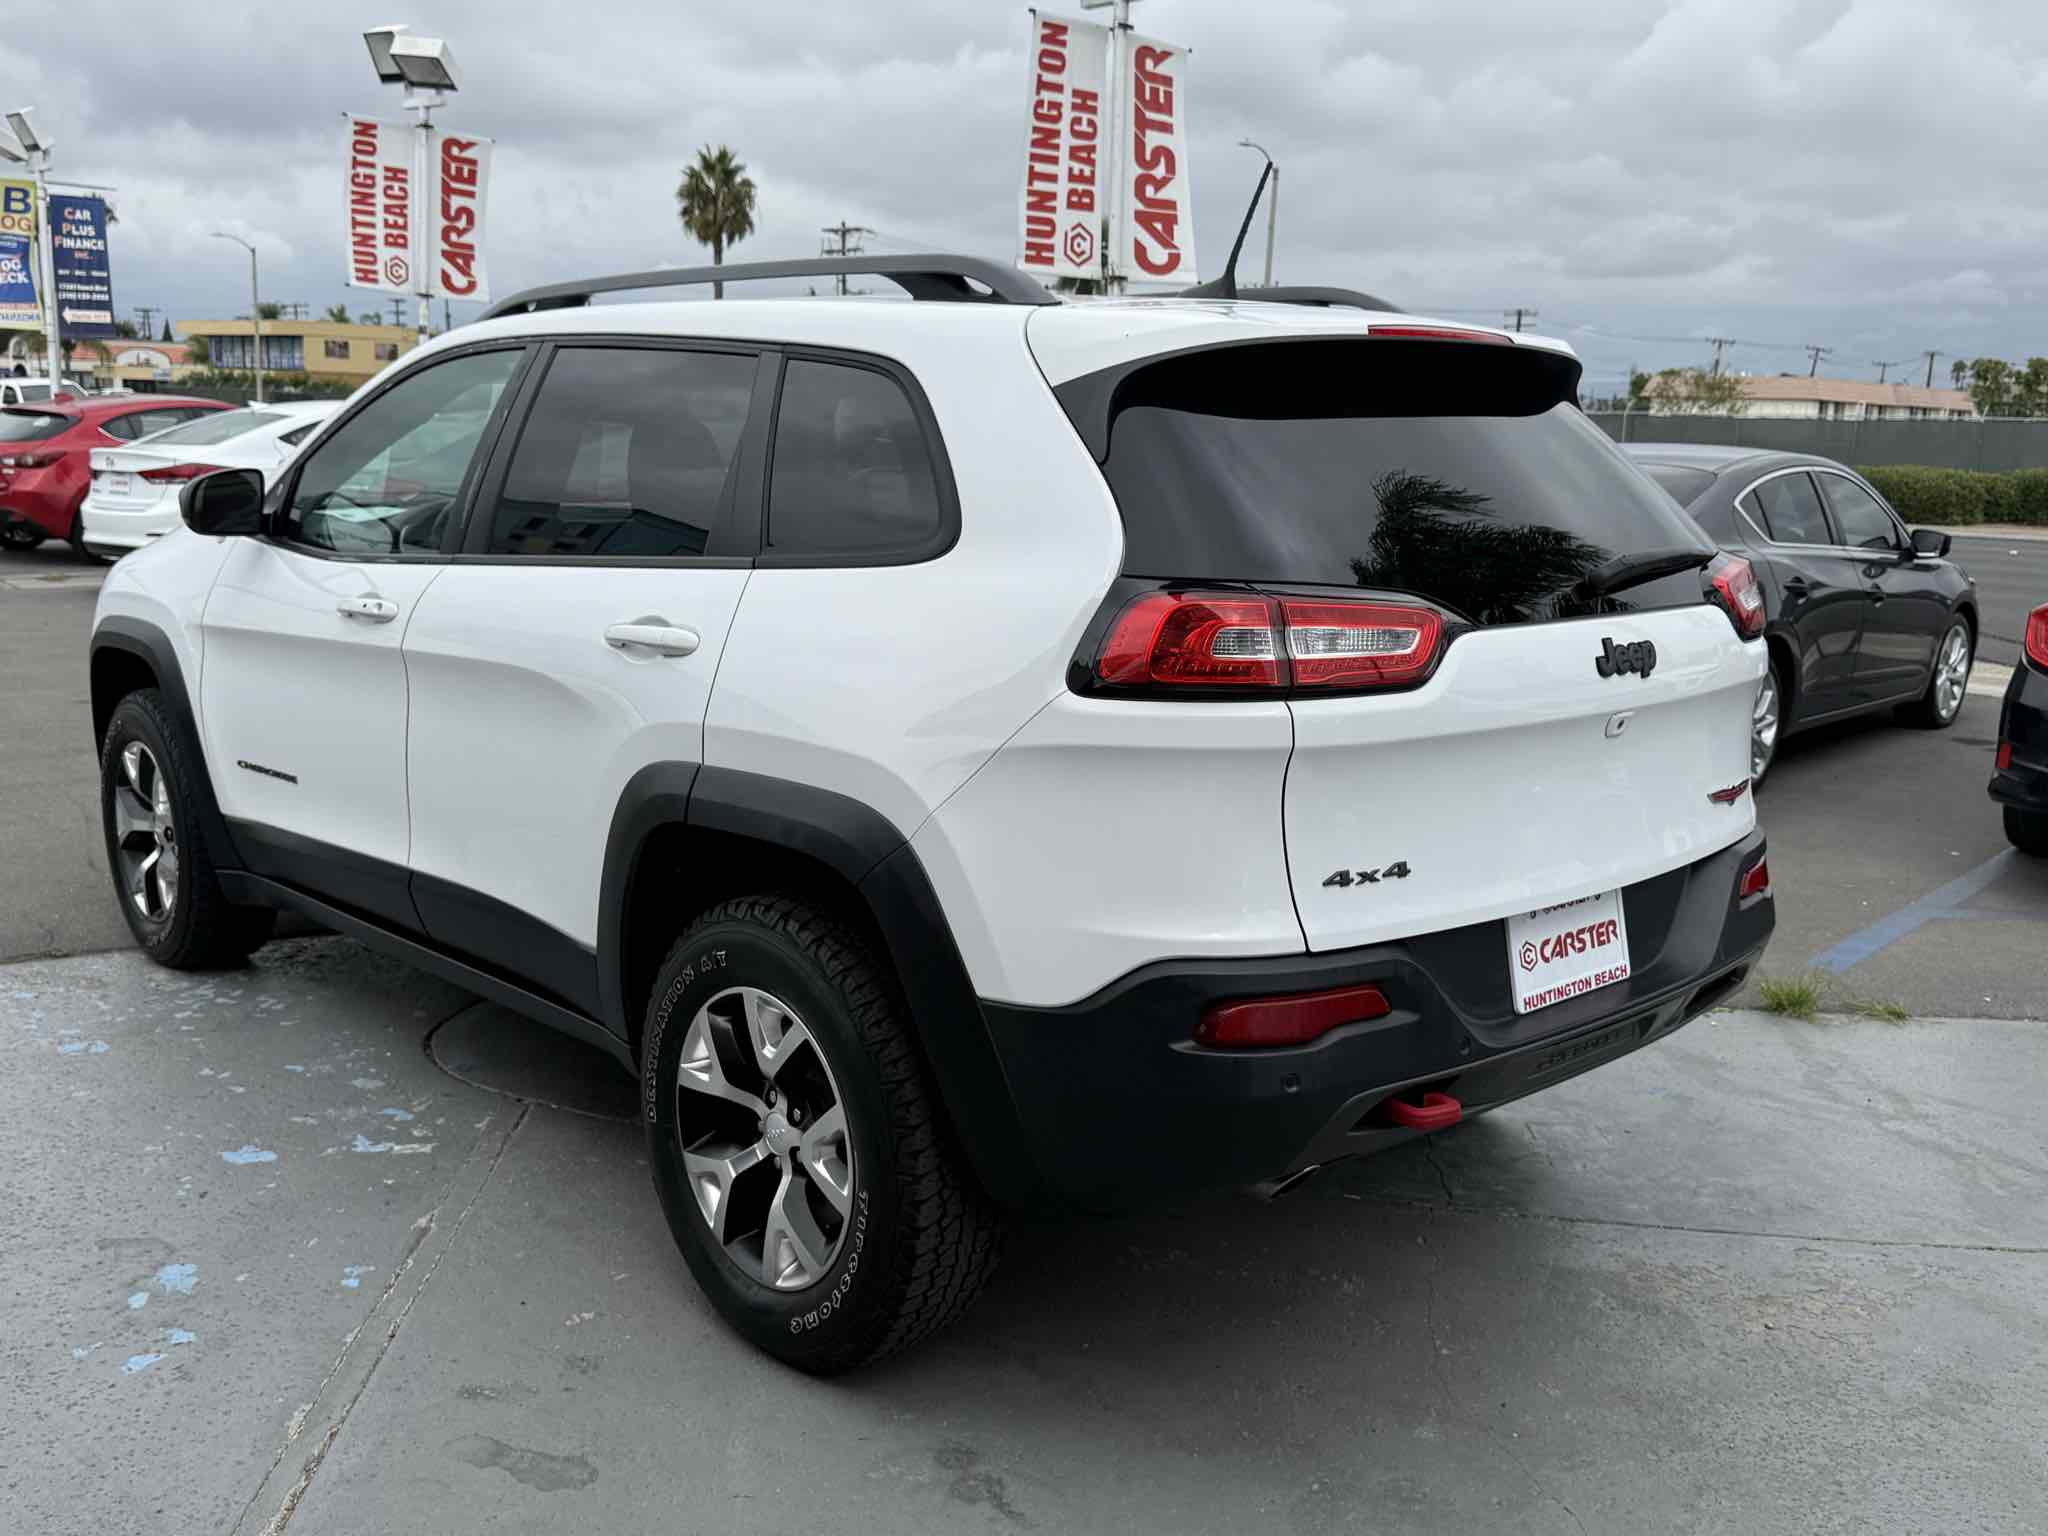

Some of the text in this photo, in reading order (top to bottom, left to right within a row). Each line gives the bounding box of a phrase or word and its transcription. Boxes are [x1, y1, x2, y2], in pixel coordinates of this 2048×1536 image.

[1024, 20, 1069, 267] HUNTINGTON
[1066, 87, 1099, 213] BEACH
[1134, 44, 1181, 276] CARSTER
[63, 207, 92, 222] CAR
[351, 120, 379, 285] HUNTINGTON
[383, 165, 408, 249] BEACH
[440, 137, 478, 296] CARSTER
[54, 235, 105, 251] FINANCE
[62, 222, 96, 237] PLUS
[1595, 636, 1657, 680] Jeep
[1322, 860, 1412, 888] 4x4
[1540, 919, 1619, 964] CARSTER
[1523, 964, 1628, 1011] HUNTINGTON BEACH
